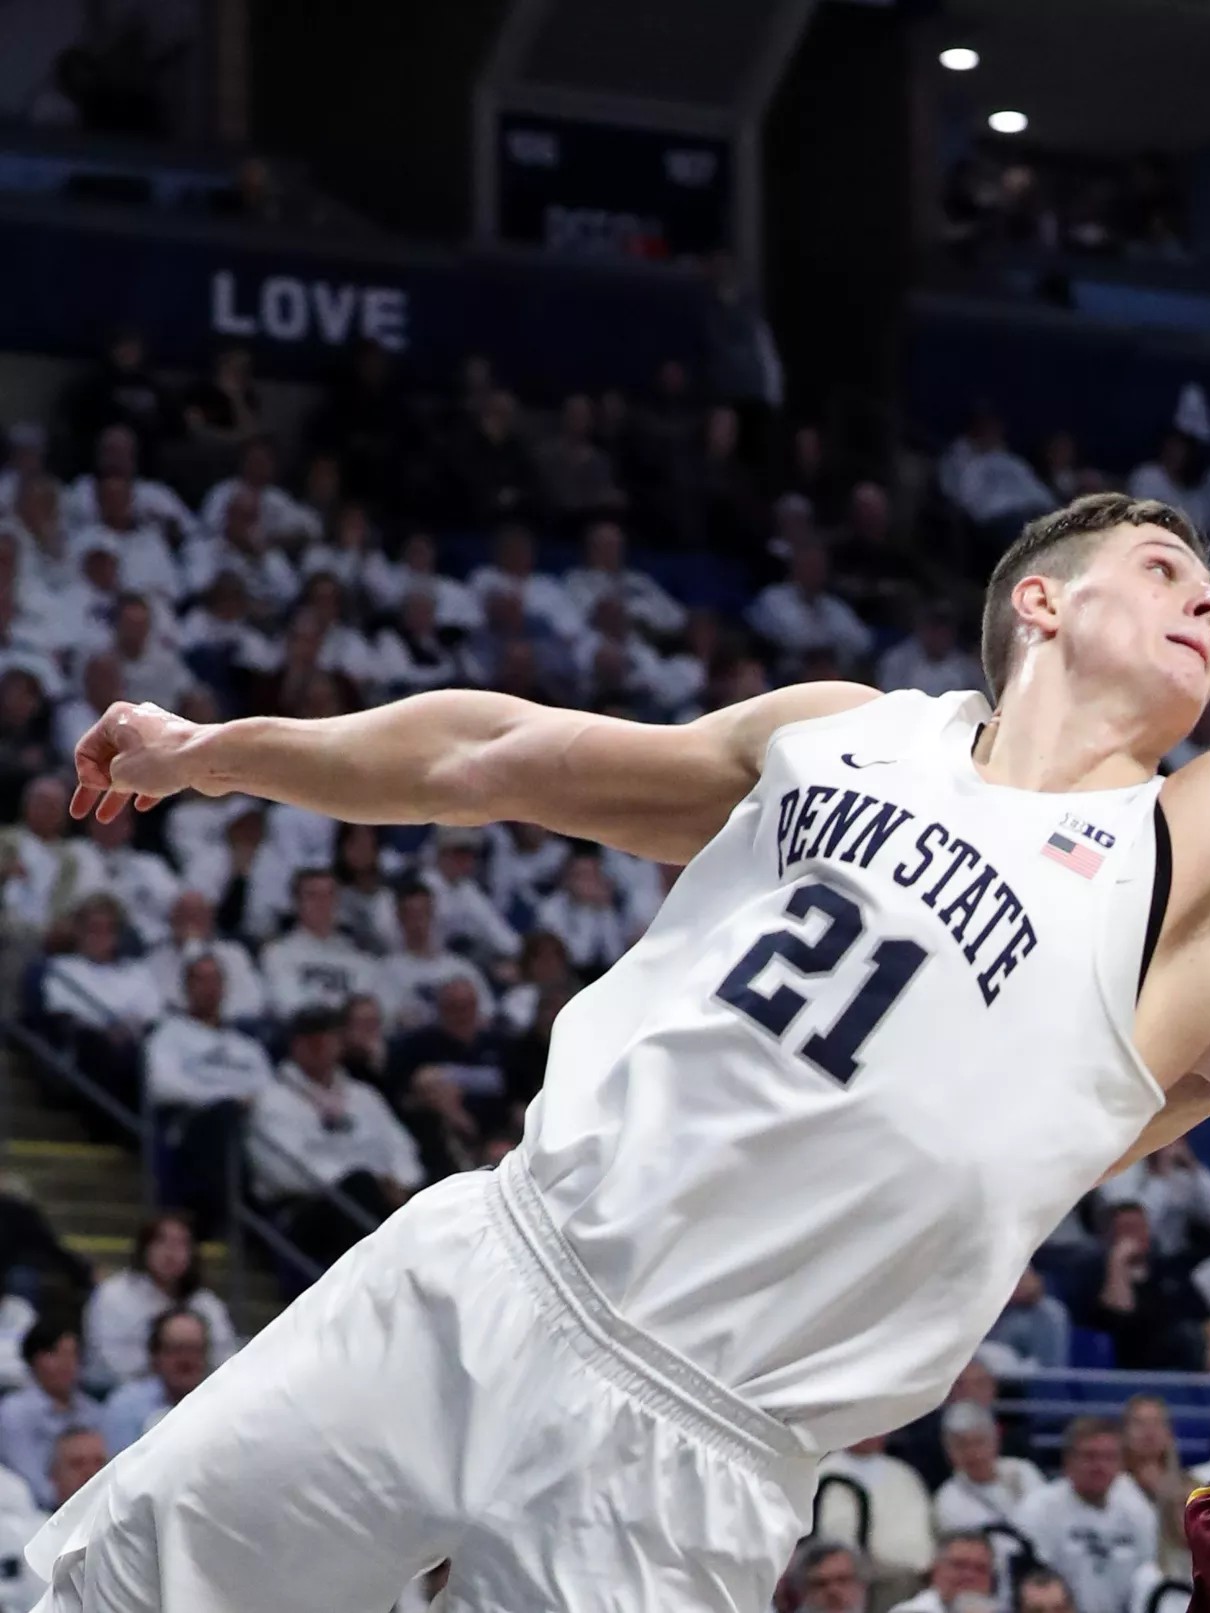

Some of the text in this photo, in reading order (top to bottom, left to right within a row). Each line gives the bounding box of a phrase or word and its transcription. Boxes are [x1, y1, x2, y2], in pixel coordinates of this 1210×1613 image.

[211, 269, 407, 350] LOVE
[710, 879, 934, 1091] 21
[776, 784, 1038, 1008] PENN STATE
